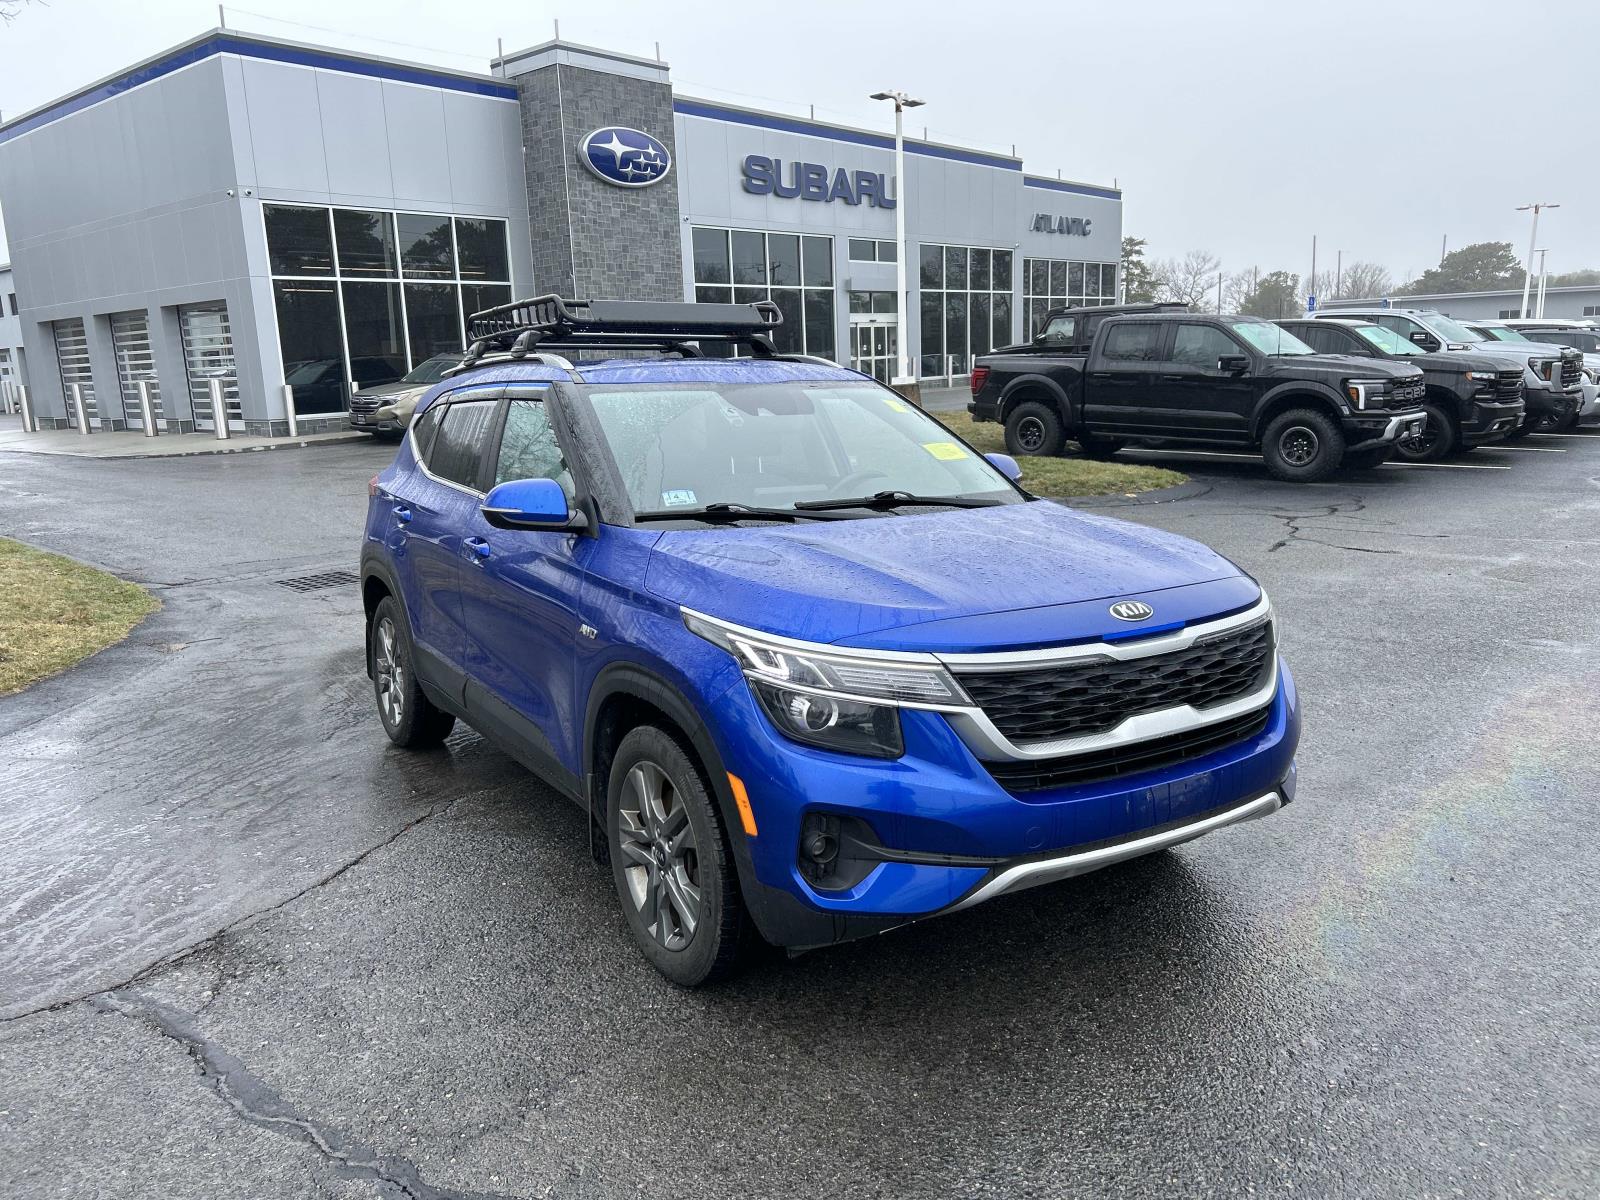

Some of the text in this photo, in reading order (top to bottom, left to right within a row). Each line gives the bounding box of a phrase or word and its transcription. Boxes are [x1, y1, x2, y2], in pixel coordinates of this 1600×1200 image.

[742, 154, 897, 209] SUBARU
[1029, 213, 1092, 236] ATLANTIC
[1115, 603, 1150, 617] KIA
